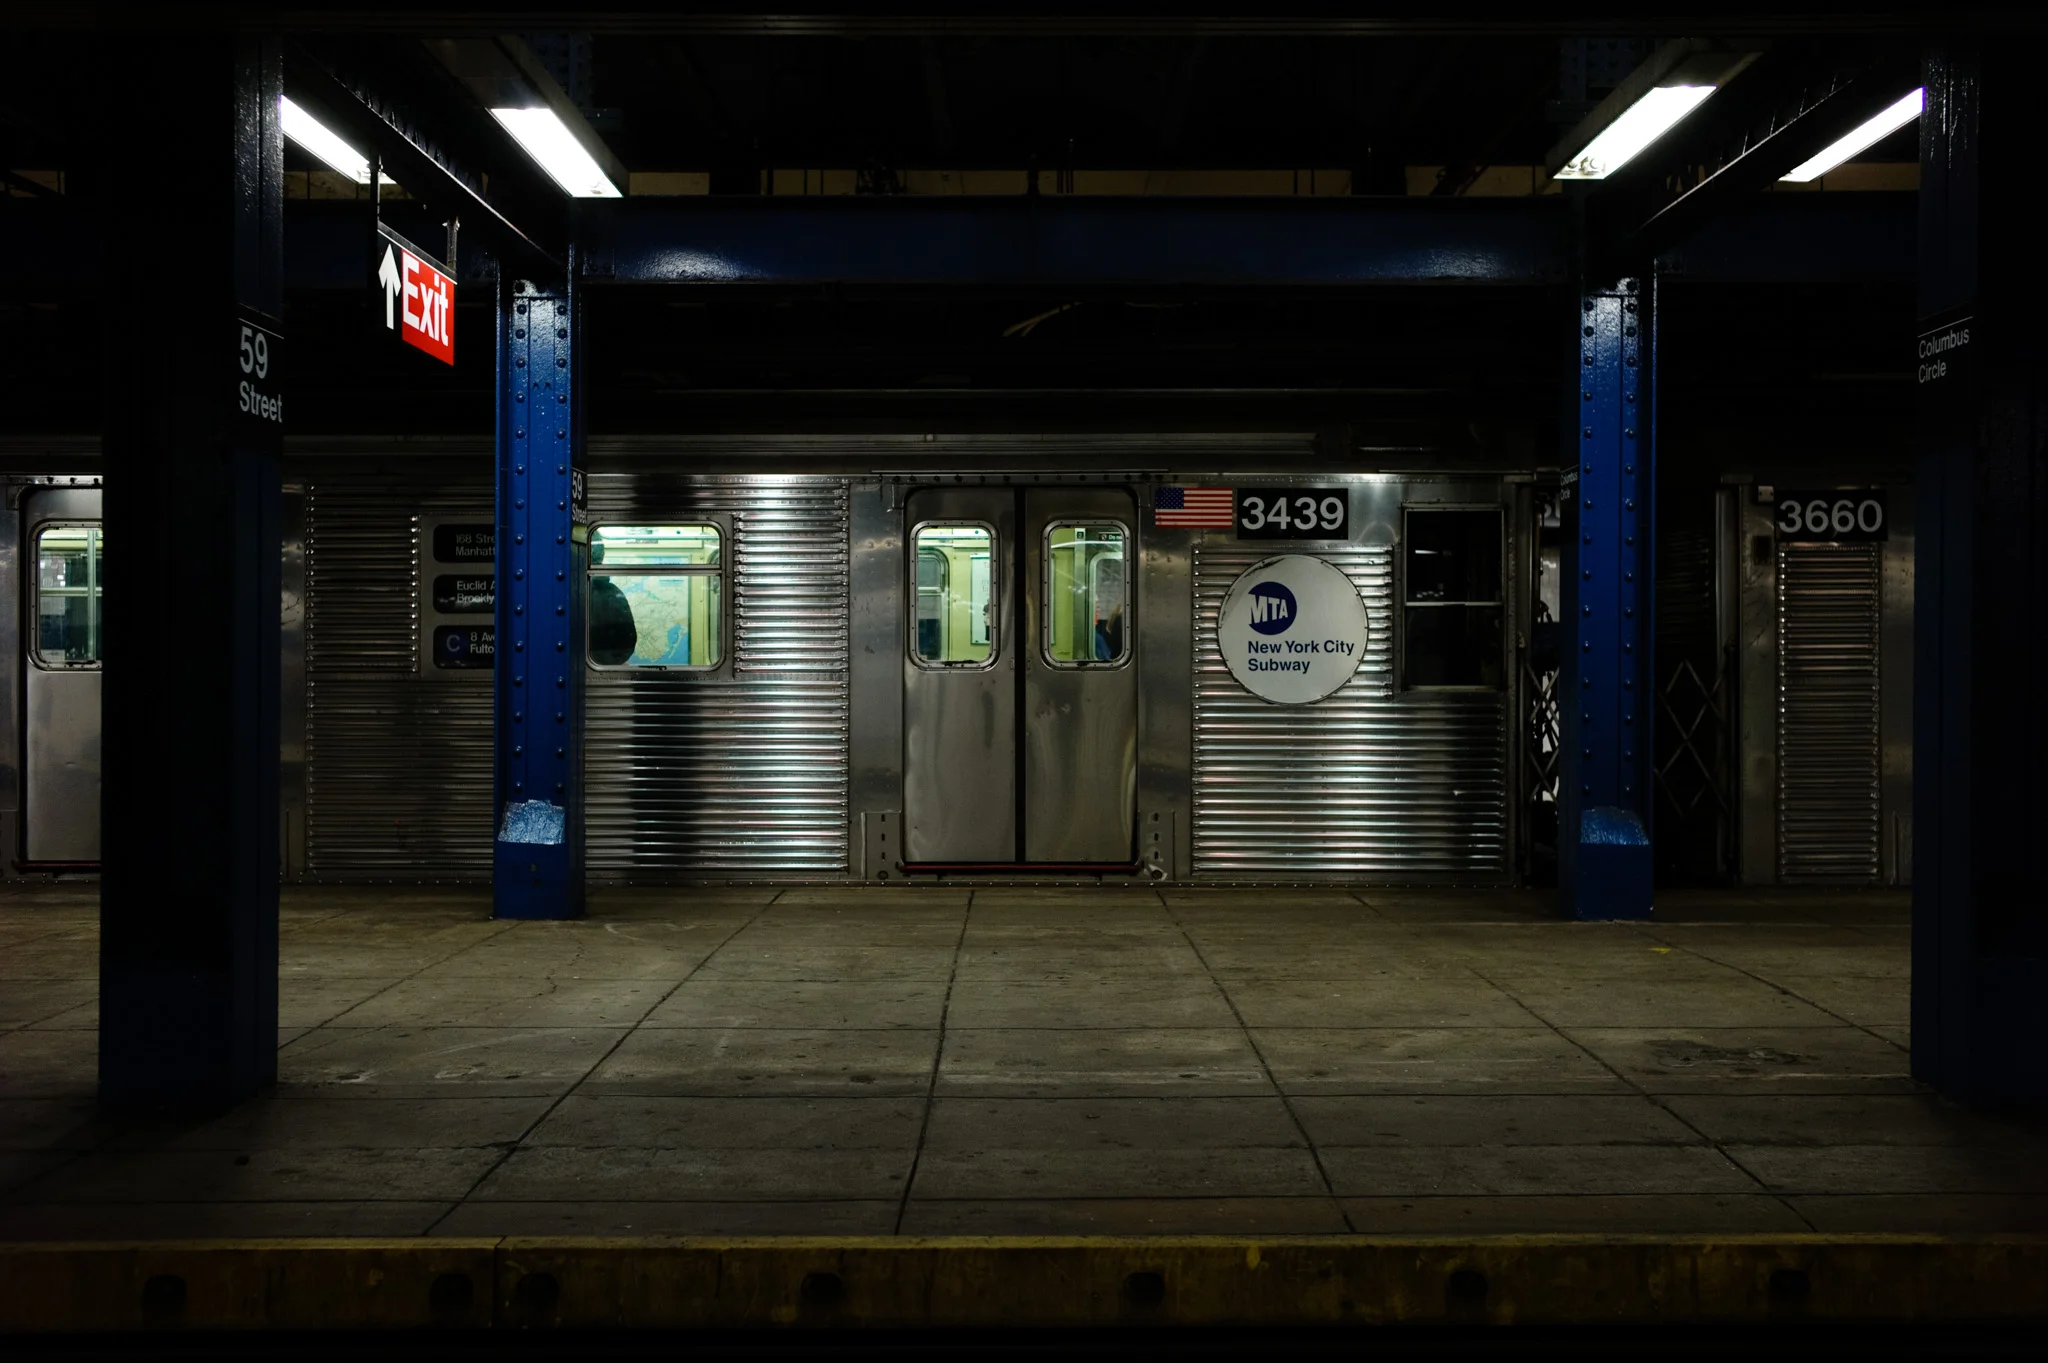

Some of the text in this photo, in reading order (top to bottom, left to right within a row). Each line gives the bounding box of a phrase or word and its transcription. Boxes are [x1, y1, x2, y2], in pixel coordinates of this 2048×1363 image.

[402, 249, 449, 347] Exit
[239, 325, 269, 380] 59
[1918, 328, 1970, 360] Columbus
[1917, 359, 1948, 384] Circle
[239, 380, 283, 424] Street
[571, 470, 583, 501] 59
[1241, 496, 1345, 531] 3439
[1778, 499, 1883, 533] 3660
[455, 532, 495, 545] 168 Stre
[455, 545, 496, 557] Manhatt
[456, 579, 487, 591] Euclid
[455, 592, 495, 605] Brookly
[1249, 594, 1289, 625] MTA
[445, 633, 461, 653] C
[470, 631, 495, 642] 8 Av
[1248, 639, 1355, 656] New York City
[469, 643, 494, 655] Fulto
[1248, 658, 1311, 675] Subway
